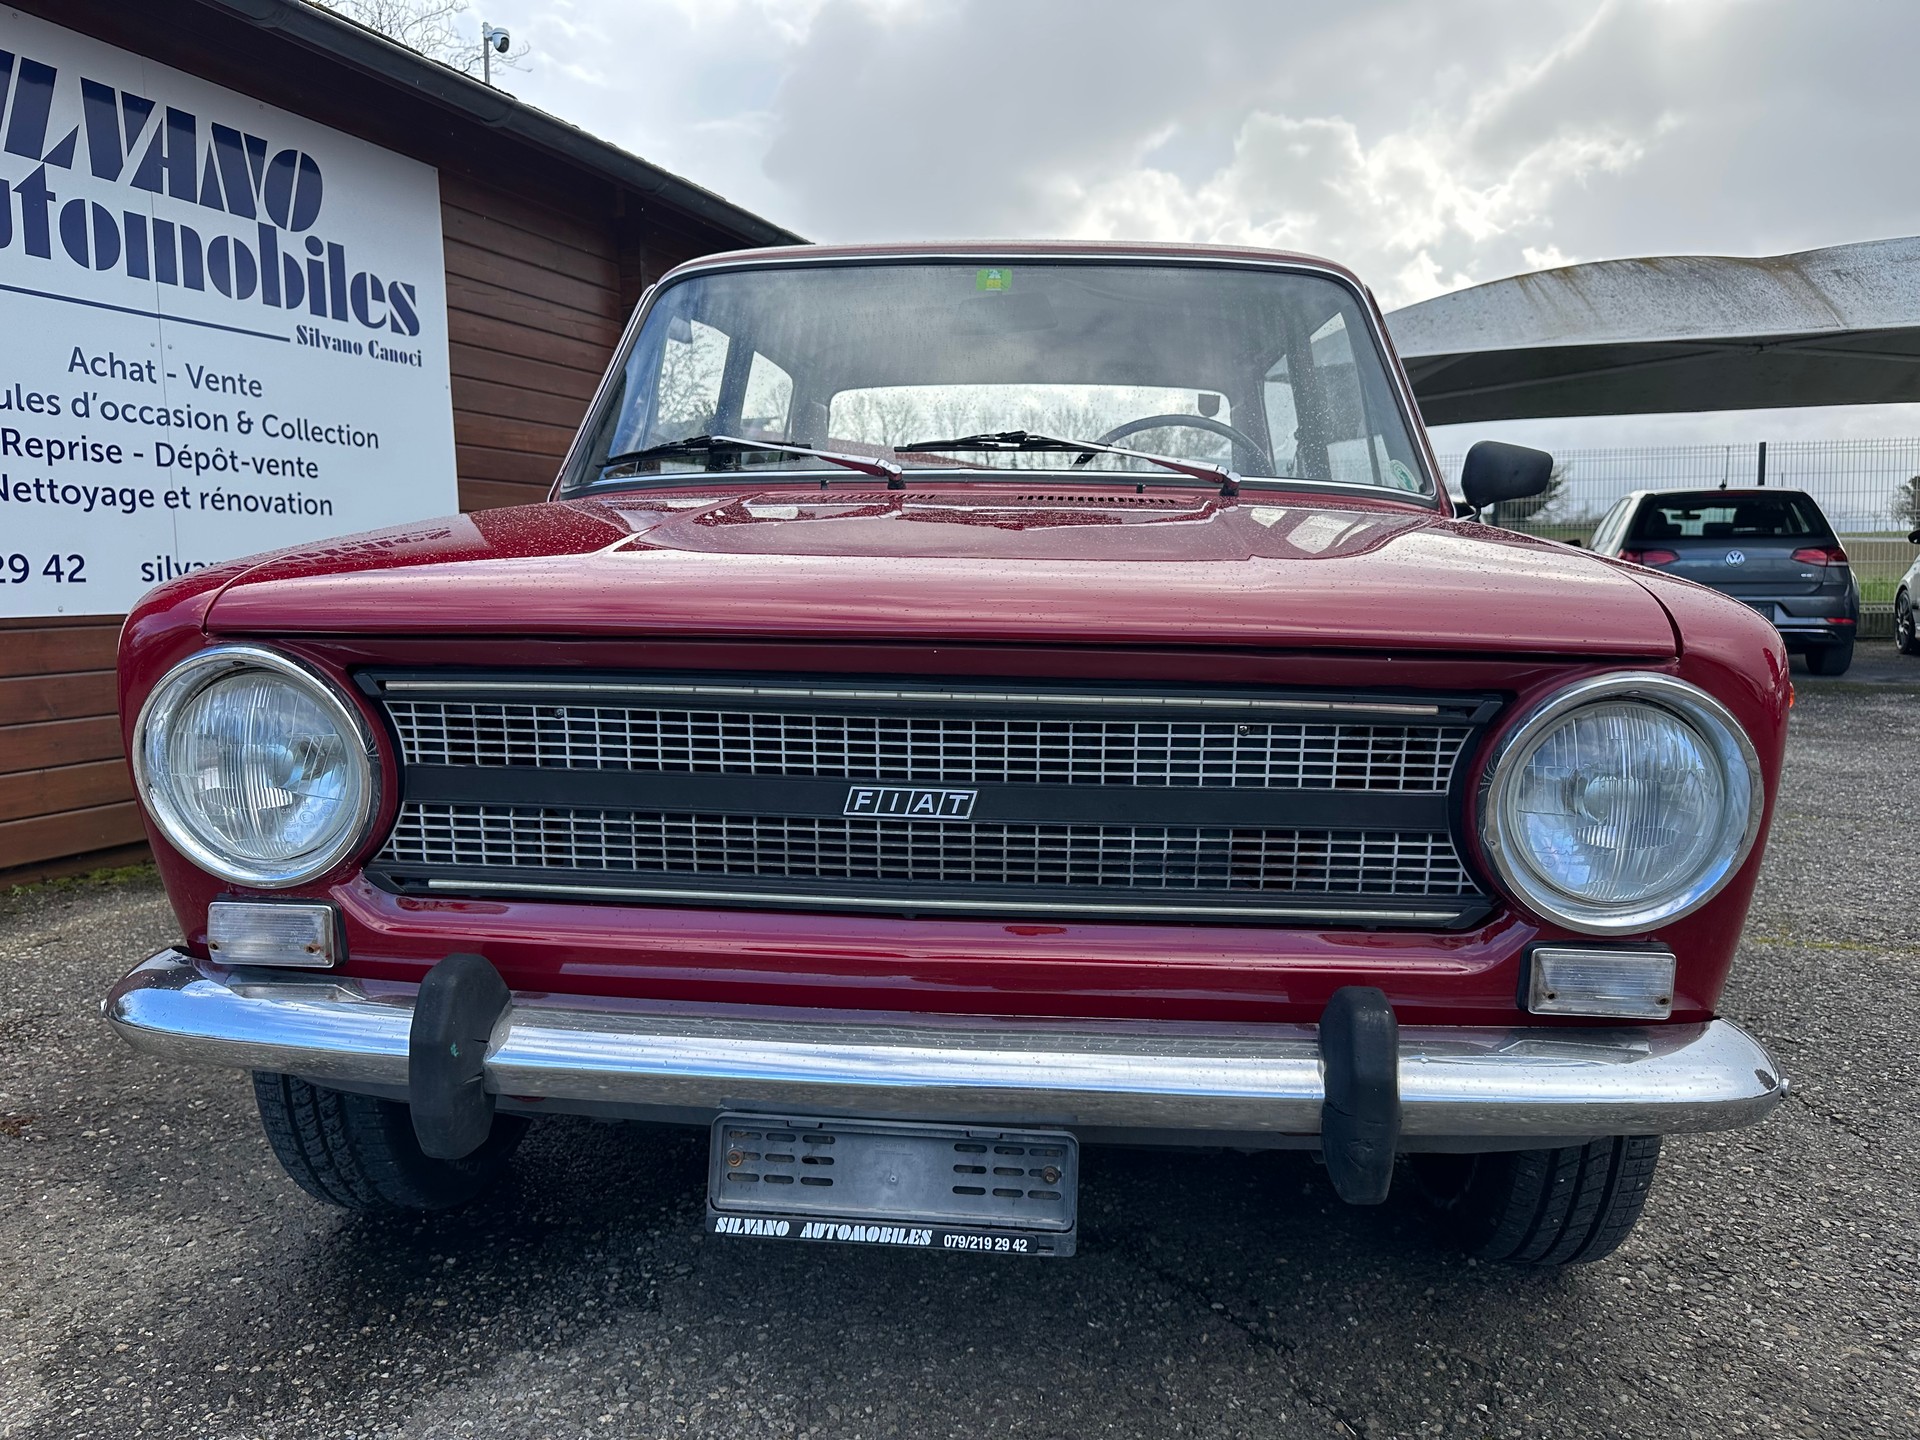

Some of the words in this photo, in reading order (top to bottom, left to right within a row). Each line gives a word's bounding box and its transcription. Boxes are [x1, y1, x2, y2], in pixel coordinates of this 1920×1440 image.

[0, 48, 323, 233] LVANO
[296, 324, 363, 356] Silvano
[368, 339, 422, 368] Canoci
[68, 346, 157, 385] Achat
[185, 363, 263, 398] Vente
[237, 410, 254, 435] &
[262, 413, 379, 449] Collection
[1, 427, 123, 466] Reprise
[155, 442, 319, 479] Dépôt-vente
[163, 486, 192, 510] et
[199, 486, 333, 516] rénovation
[42, 554, 87, 583] 42
[854, 791, 969, 814] FIAT
[714, 1217, 790, 1237] SILVANO
[799, 1222, 933, 1245] AUTOMOBILES
[943, 1234, 993, 1250] 079/219
[994, 1238, 1010, 1251] 29
[1012, 1238, 1028, 1252] 42
